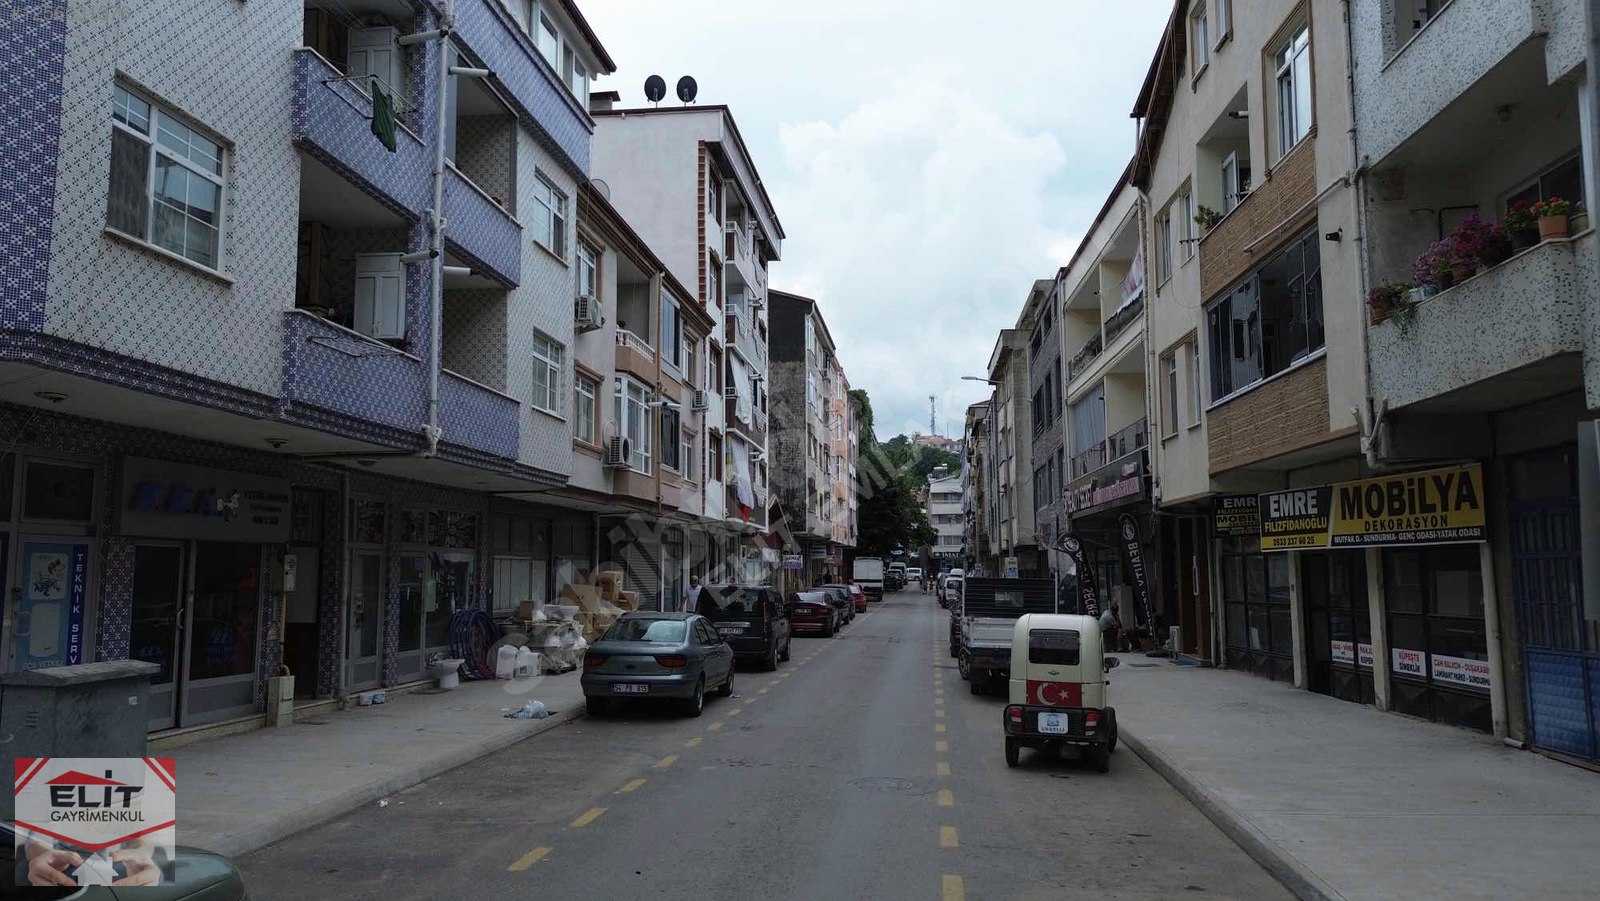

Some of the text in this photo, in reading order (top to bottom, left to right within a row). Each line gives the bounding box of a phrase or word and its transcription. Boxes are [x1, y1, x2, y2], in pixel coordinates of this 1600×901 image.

[1223, 497, 1257, 508] EMR
[1269, 490, 1318, 518] EMRE
[1364, 515, 1448, 532] DEKORASYON
[1334, 535, 1355, 543] MUTFAK
[1398, 532, 1416, 542] GENÇ
[1458, 528, 1481, 536] ODASI
